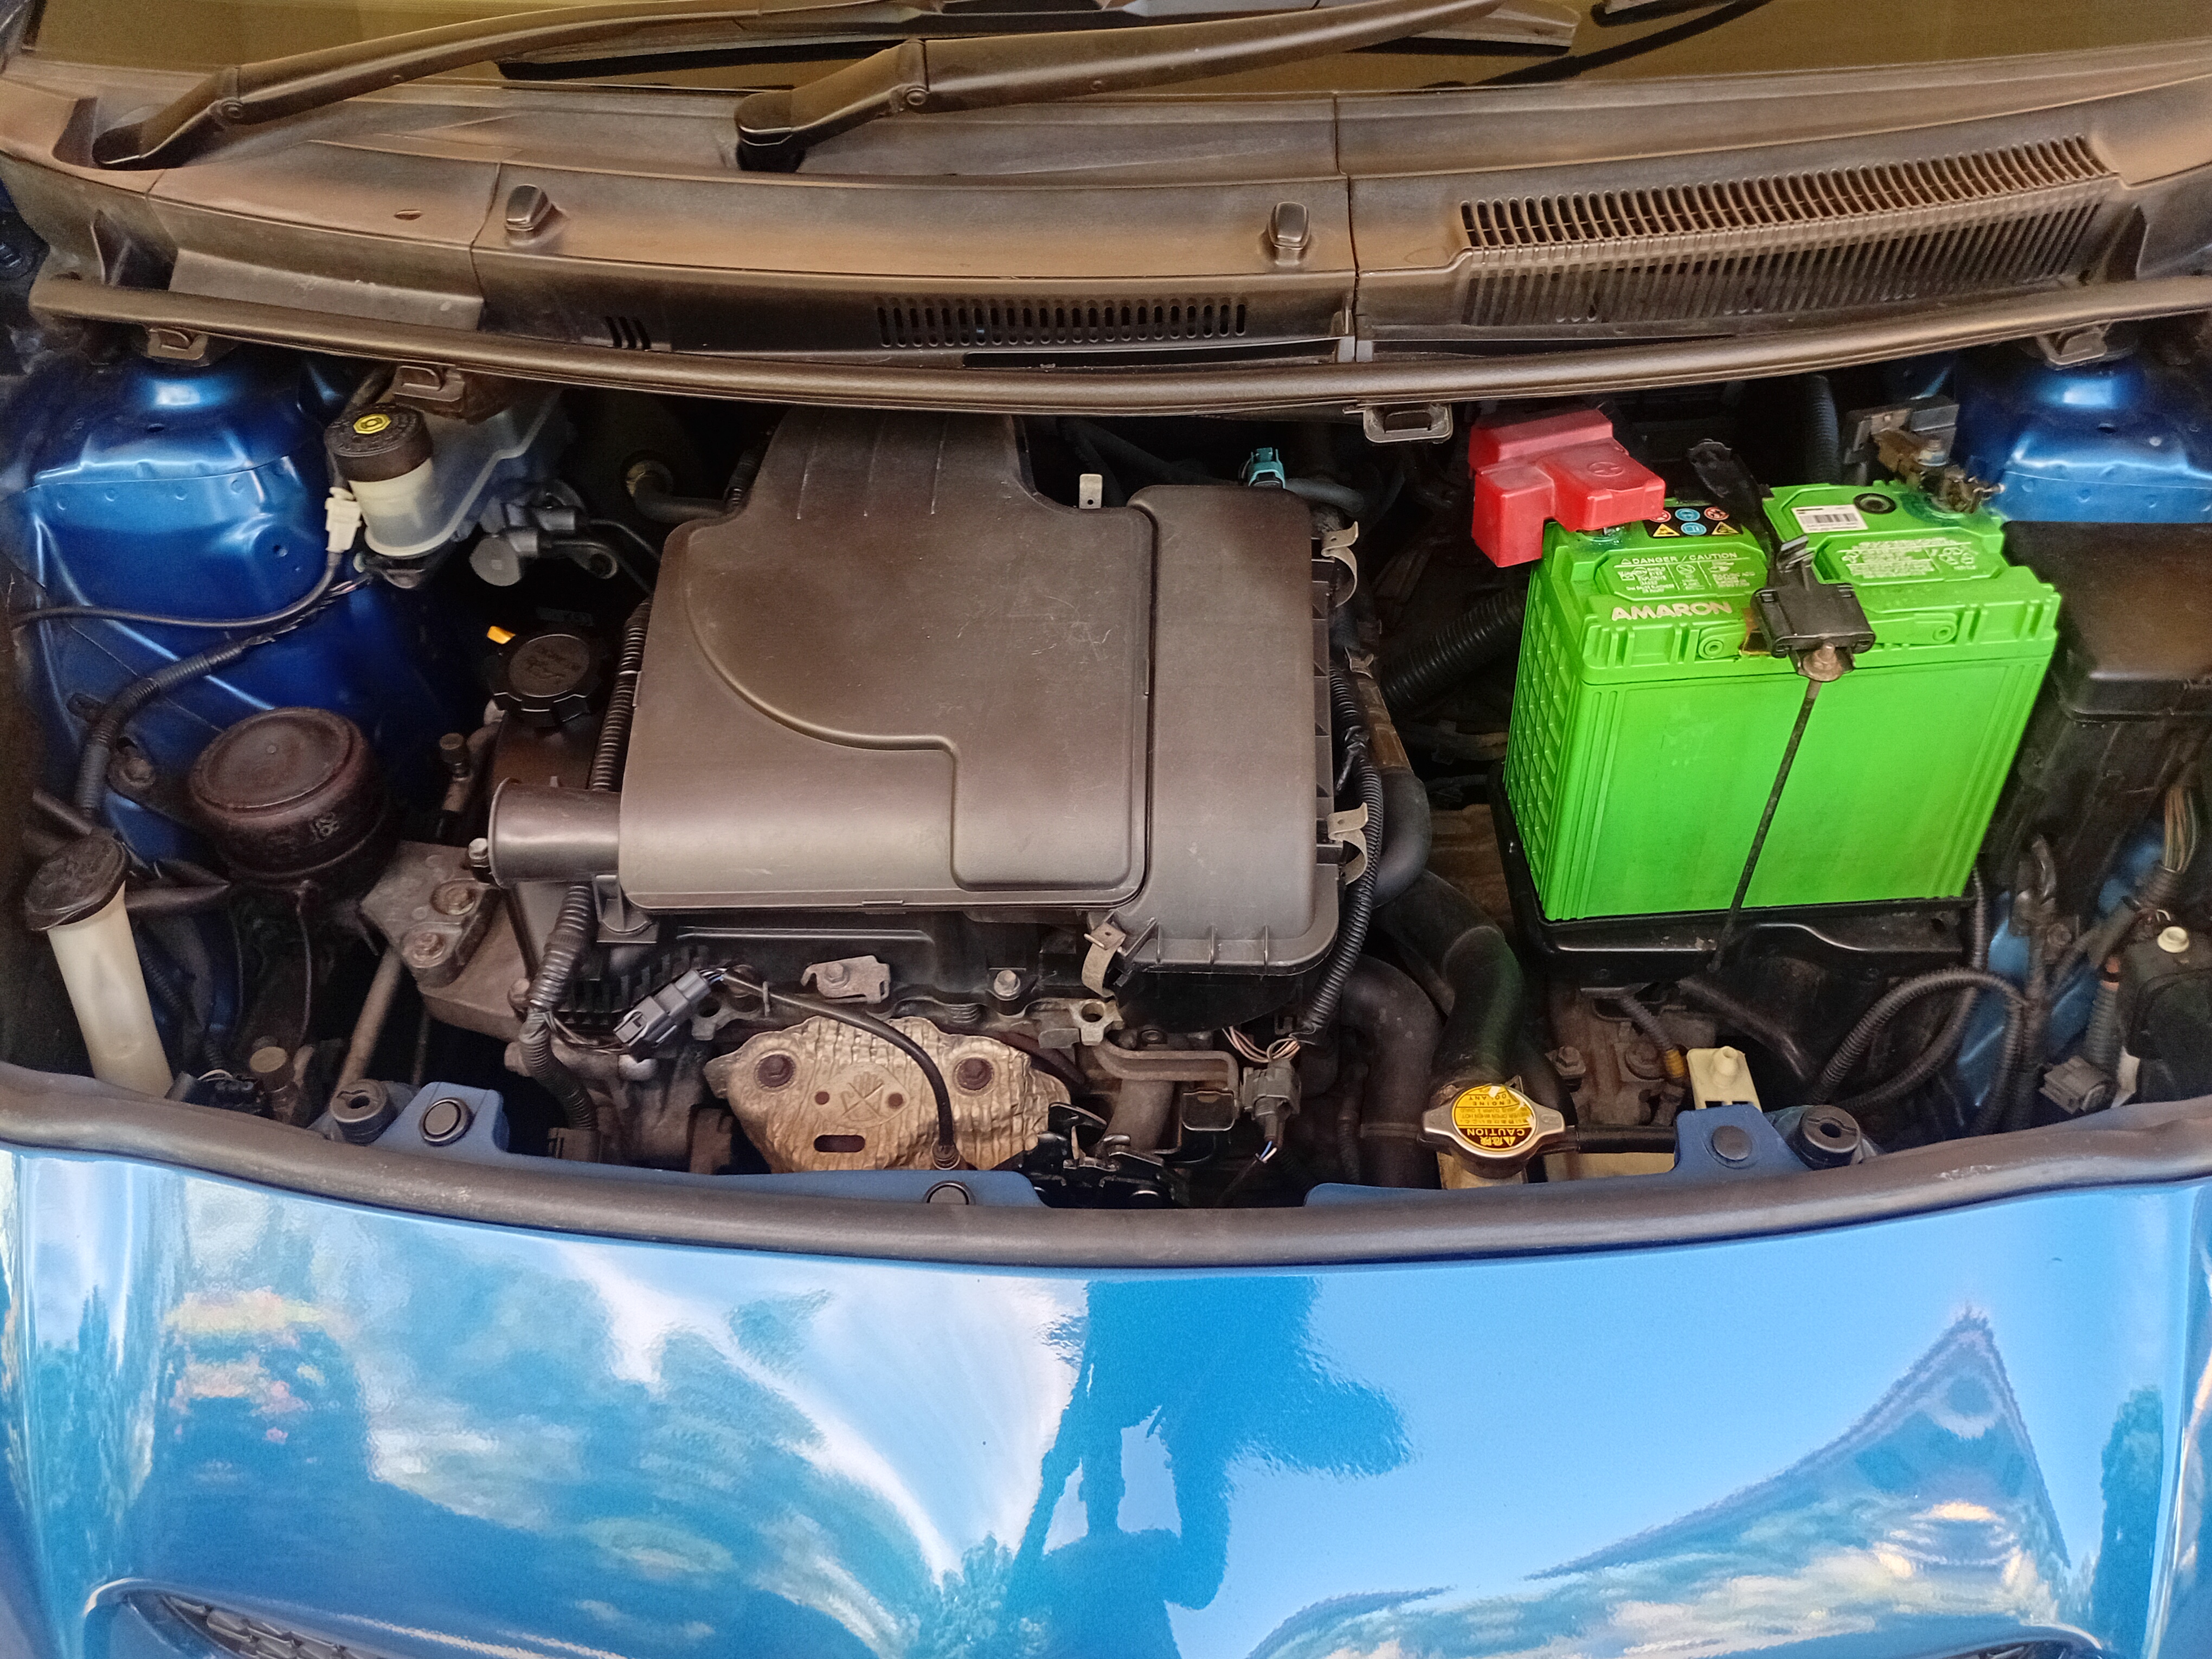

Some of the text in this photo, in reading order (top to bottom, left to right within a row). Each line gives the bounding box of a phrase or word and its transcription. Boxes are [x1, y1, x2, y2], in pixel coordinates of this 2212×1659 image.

[1632, 556, 1678, 564] DANGER
[1689, 552, 1738, 561] CAUTION
[1611, 601, 1732, 621] AMARON
[1480, 1136, 1503, 1146] 危険
